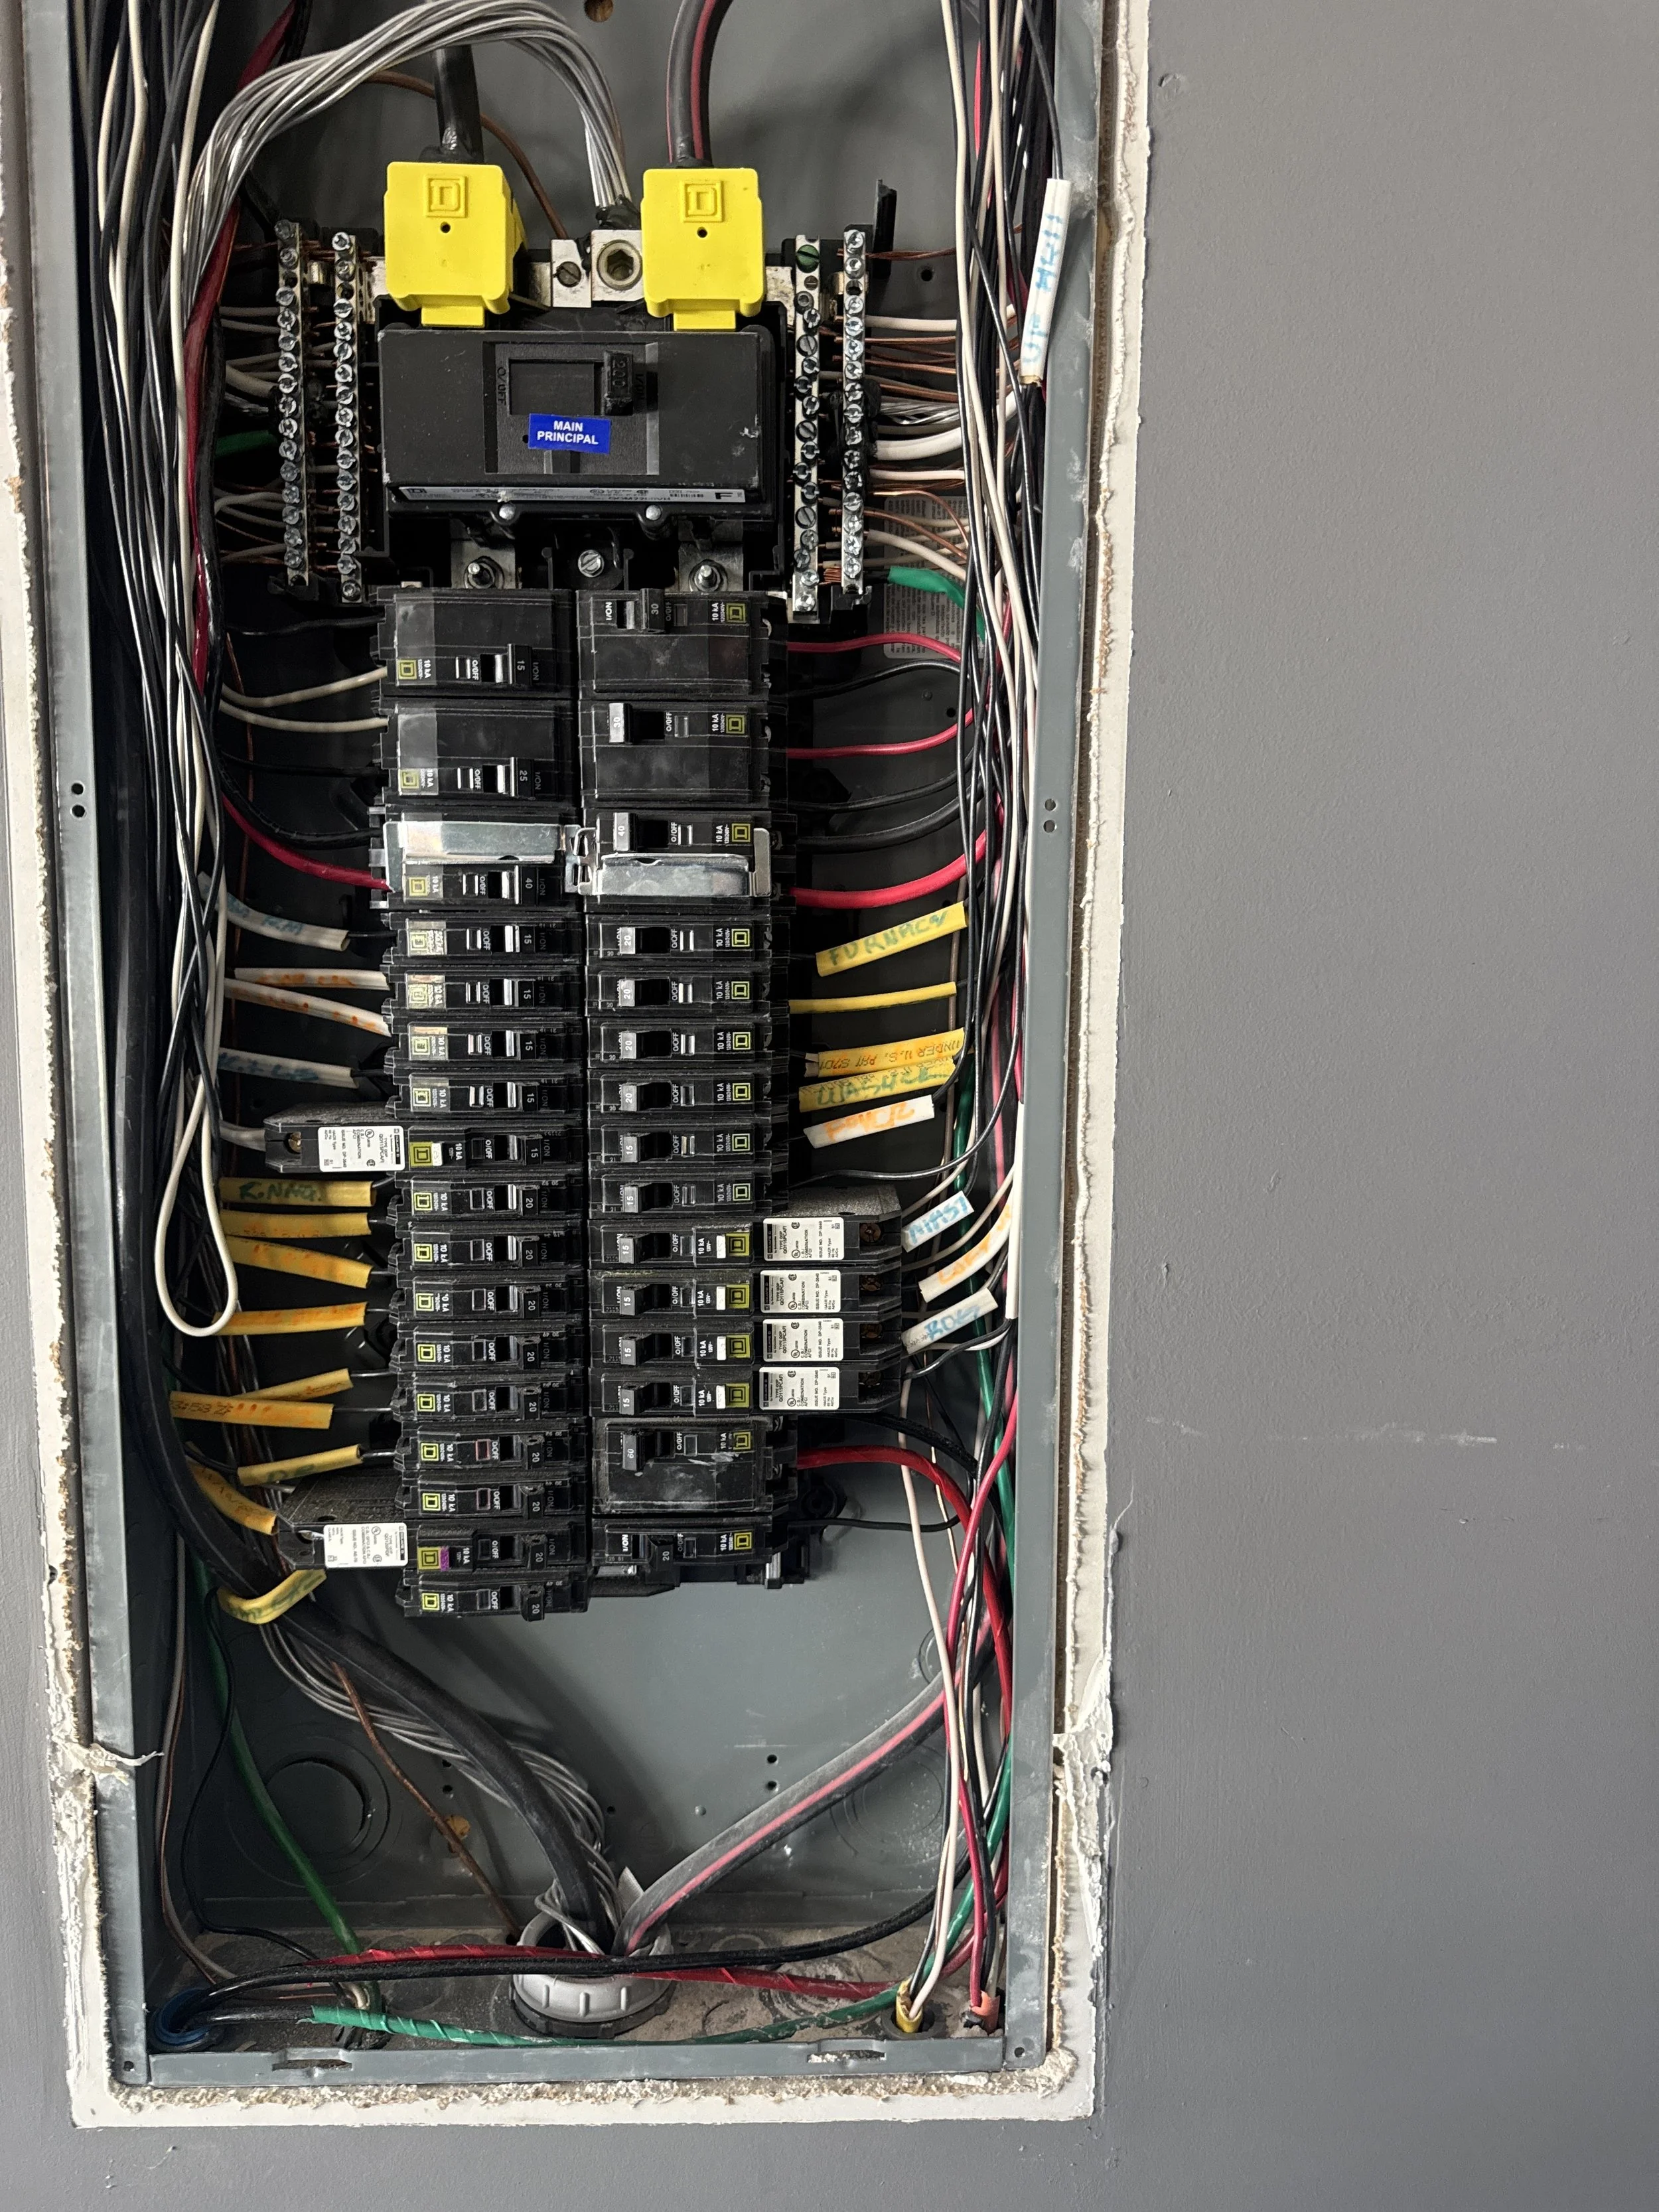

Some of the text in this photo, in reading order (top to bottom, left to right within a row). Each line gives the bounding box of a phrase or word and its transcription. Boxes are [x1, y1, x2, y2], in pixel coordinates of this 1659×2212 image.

[613, 360, 626, 388] 200
[553, 420, 583, 432] MAIN
[537, 431, 599, 445] PRINCIPAL
[652, 603, 658, 615] 30
[711, 603, 719, 612] kA
[517, 660, 525, 670] 15
[424, 668, 431, 678] kA
[614, 717, 620, 727] 30
[711, 713, 719, 723] kA
[520, 770, 527, 781] 25
[618, 826, 625, 836] 40
[526, 878, 532, 889] 40
[715, 928, 723, 936] kA
[524, 934, 531, 944] 15
[624, 934, 631, 946] 20
[524, 990, 531, 999] 15
[624, 989, 630, 999] 20
[526, 1041, 533, 1051] 15
[625, 1041, 632, 1051] 20
[527, 1093, 534, 1102] 15
[625, 1092, 632, 1103] 20
[440, 1099, 447, 1108] kA
[531, 1147, 538, 1157] 15
[626, 1145, 633, 1155] 15
[456, 1151, 463, 1160] kA
[526, 1198, 533, 1209] 20
[627, 1196, 633, 1205] 15
[441, 1203, 448, 1211] kA
[622, 1245, 629, 1254] 15
[526, 1250, 533, 1260] 20
[528, 1300, 535, 1311] 20
[624, 1297, 630, 1307] 15
[528, 1352, 535, 1362] 20
[624, 1347, 631, 1357] 15
[530, 1402, 537, 1412] 20
[623, 1398, 630, 1408] 15
[443, 1404, 451, 1413] kA
[447, 1453, 454, 1462] kA
[532, 1452, 540, 1462] 20
[449, 1503, 456, 1512] kA
[533, 1501, 540, 1512] 20
[536, 1552, 543, 1562] 20
[662, 1551, 670, 1561] 20
[447, 1603, 455, 1612] kA
[532, 1604, 540, 1614] 20
